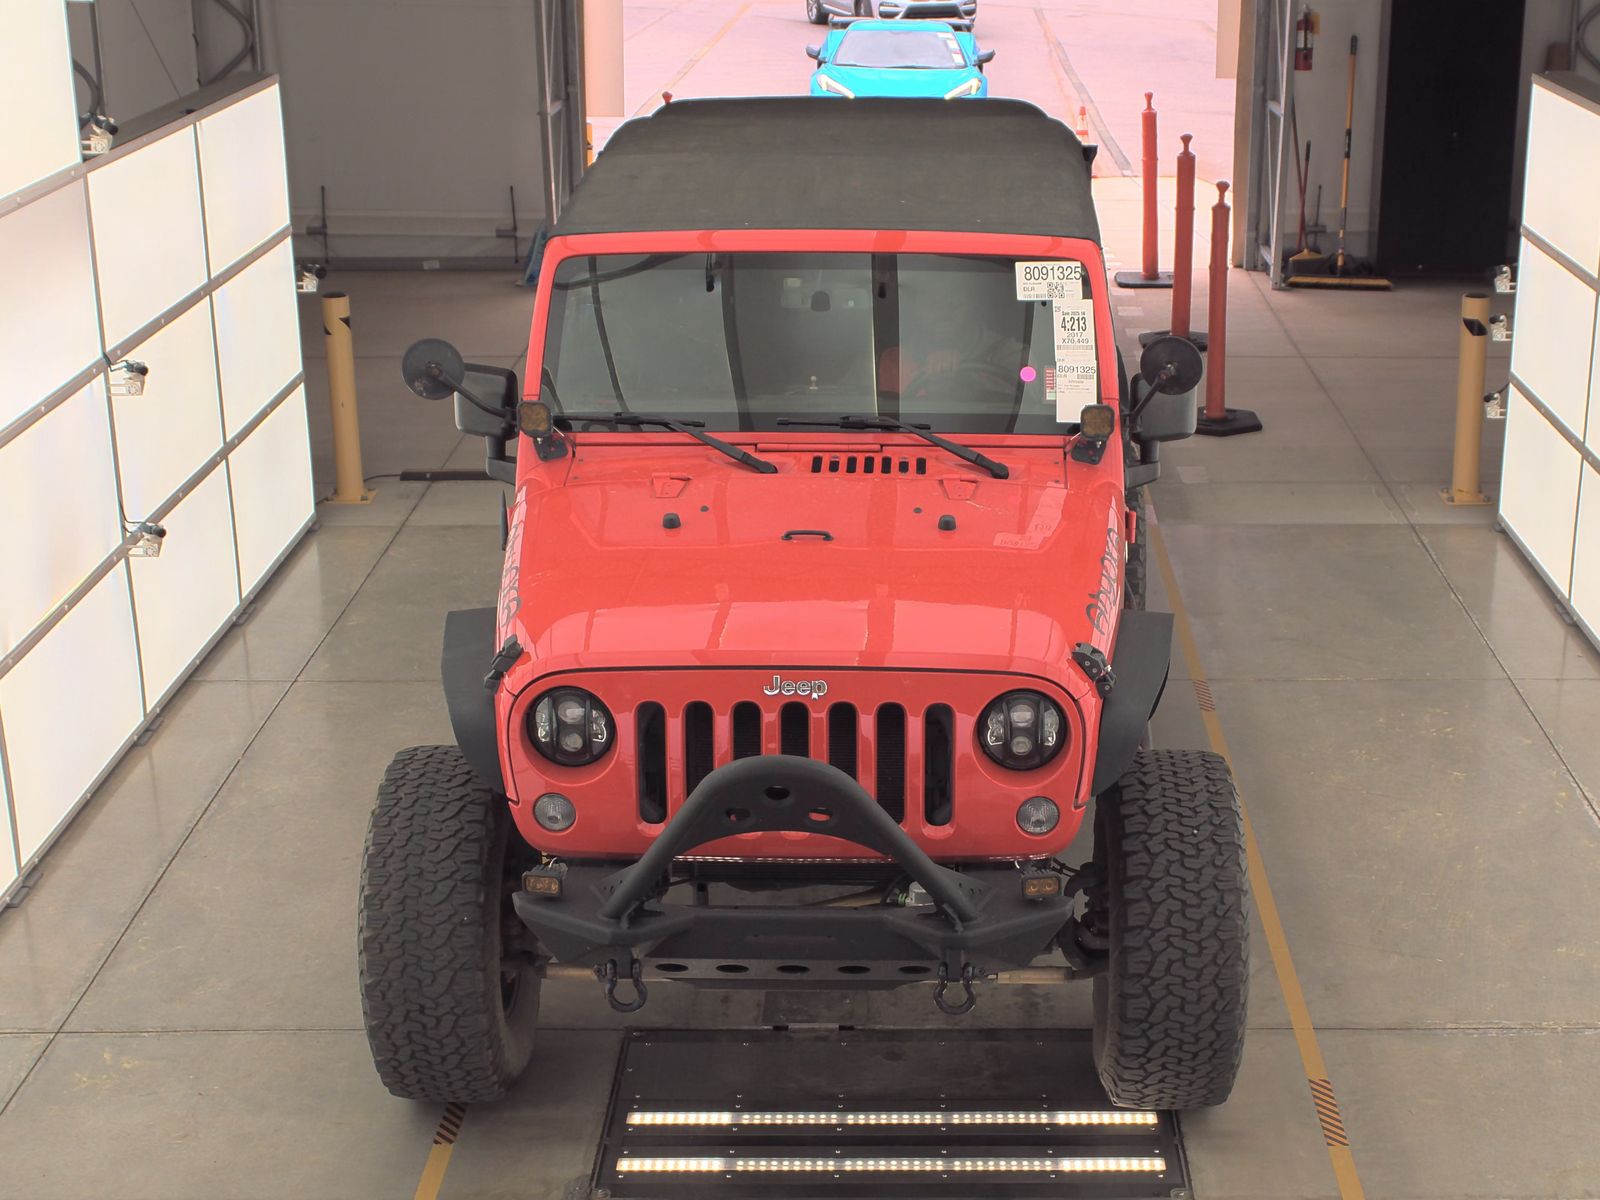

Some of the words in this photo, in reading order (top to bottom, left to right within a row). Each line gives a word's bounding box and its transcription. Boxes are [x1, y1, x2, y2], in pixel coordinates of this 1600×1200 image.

[1024, 265, 1082, 281] 8091325
[1060, 316, 1087, 332] 4:213
[1058, 365, 1096, 374] 8091325
[763, 674, 828, 701] Jeep
